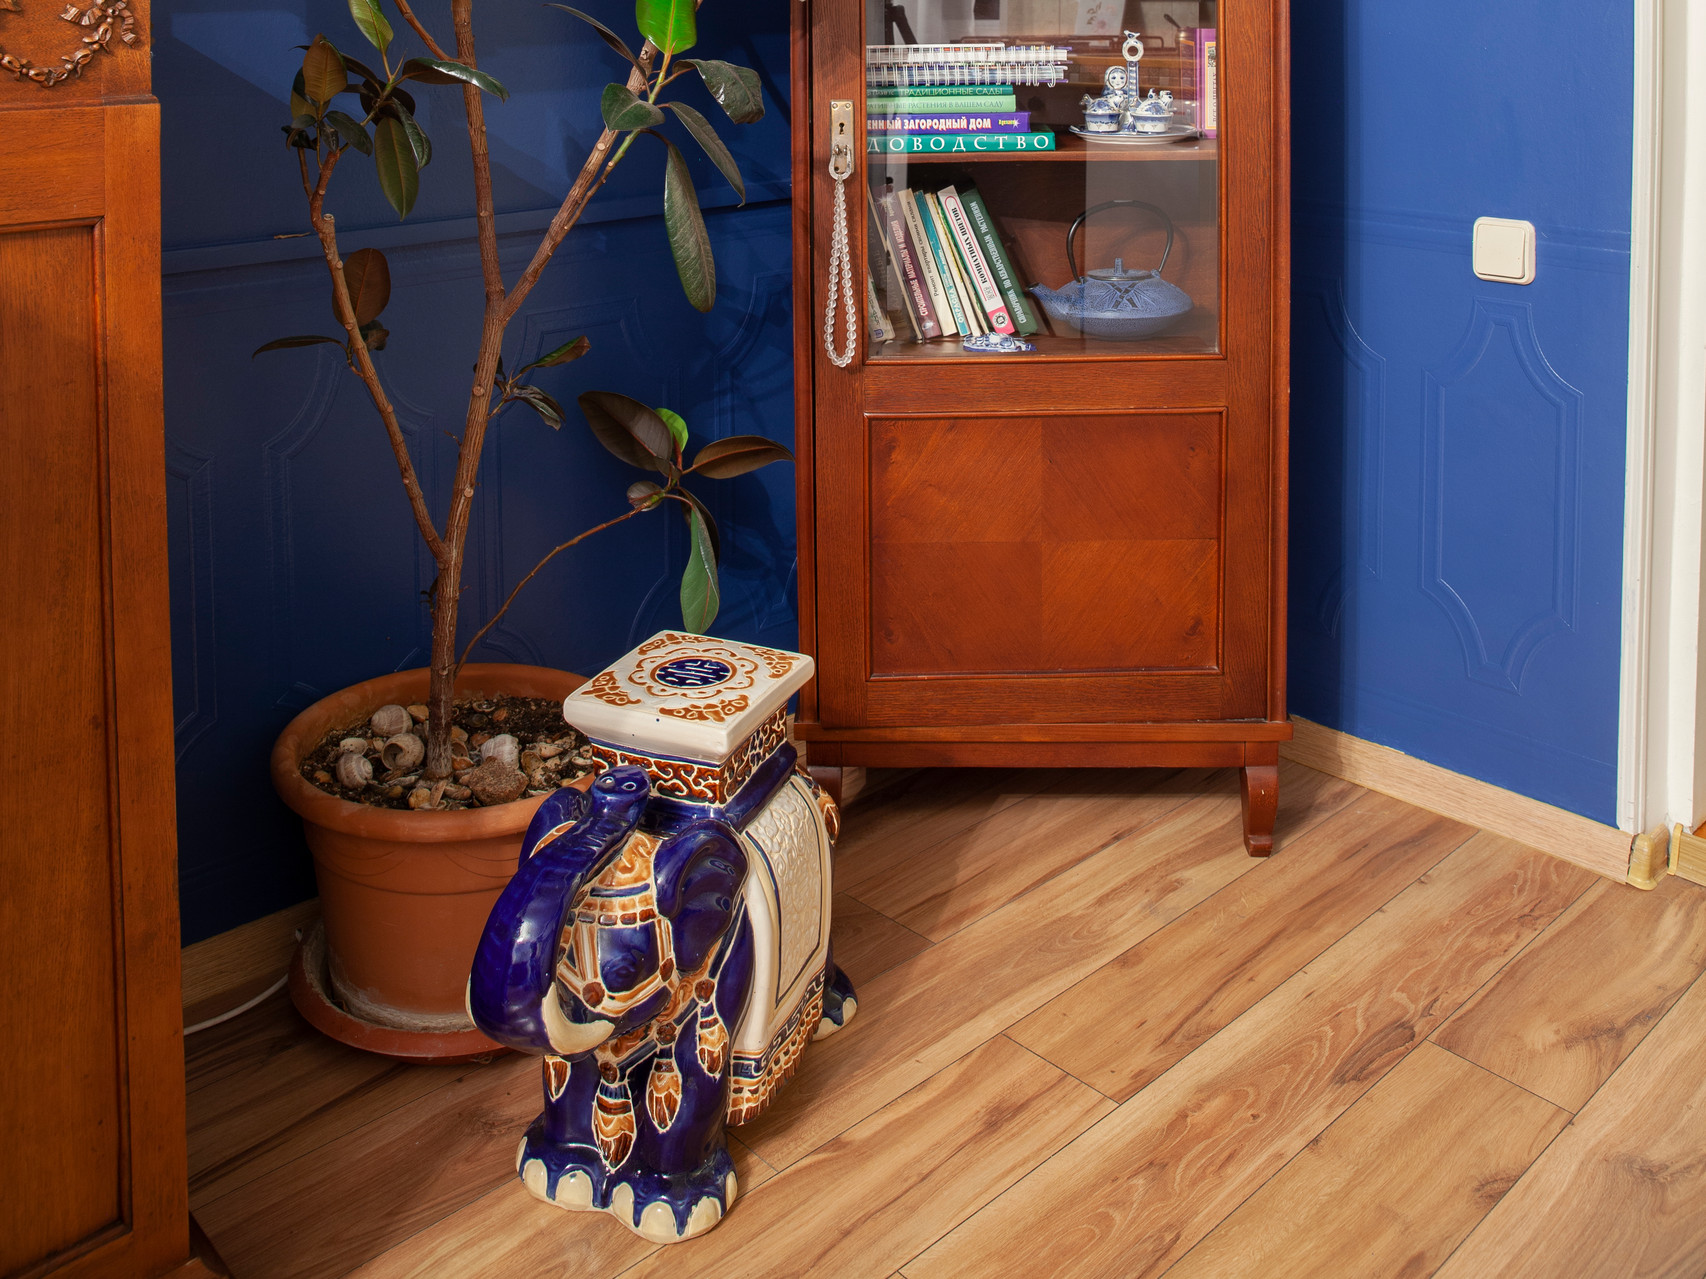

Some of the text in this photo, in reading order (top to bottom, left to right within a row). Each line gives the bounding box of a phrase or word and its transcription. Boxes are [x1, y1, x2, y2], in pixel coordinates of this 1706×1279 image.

[900, 88, 973, 96] ТРАДИЦИОННЫЕ
[975, 87, 1003, 95] САДЫ
[909, 101, 947, 109] РАСТЕНИЯ
[983, 100, 1004, 109] САДУ
[903, 116, 967, 131] ЗАГОРОДНЫЙ
[968, 118, 992, 130] ДОМ
[891, 220, 904, 243] ИЗДЕЛИЯ
[951, 208, 968, 236] ЦВЕТОВ
[900, 248, 916, 279] МАТЕРИАЛЫ
[907, 201, 939, 297] Ремонт квартиры своими силами
[964, 237, 988, 284] КОМНАТНЫХ
[970, 201, 1027, 324] СПРАВОЧНИК ПО ЛЕКАРСТВЕННЫМ РАСТЕНИЯМ
[910, 279, 928, 317] СТРОИТЕЛЬНЫЕ
[949, 288, 964, 324] ОКРАСКА
